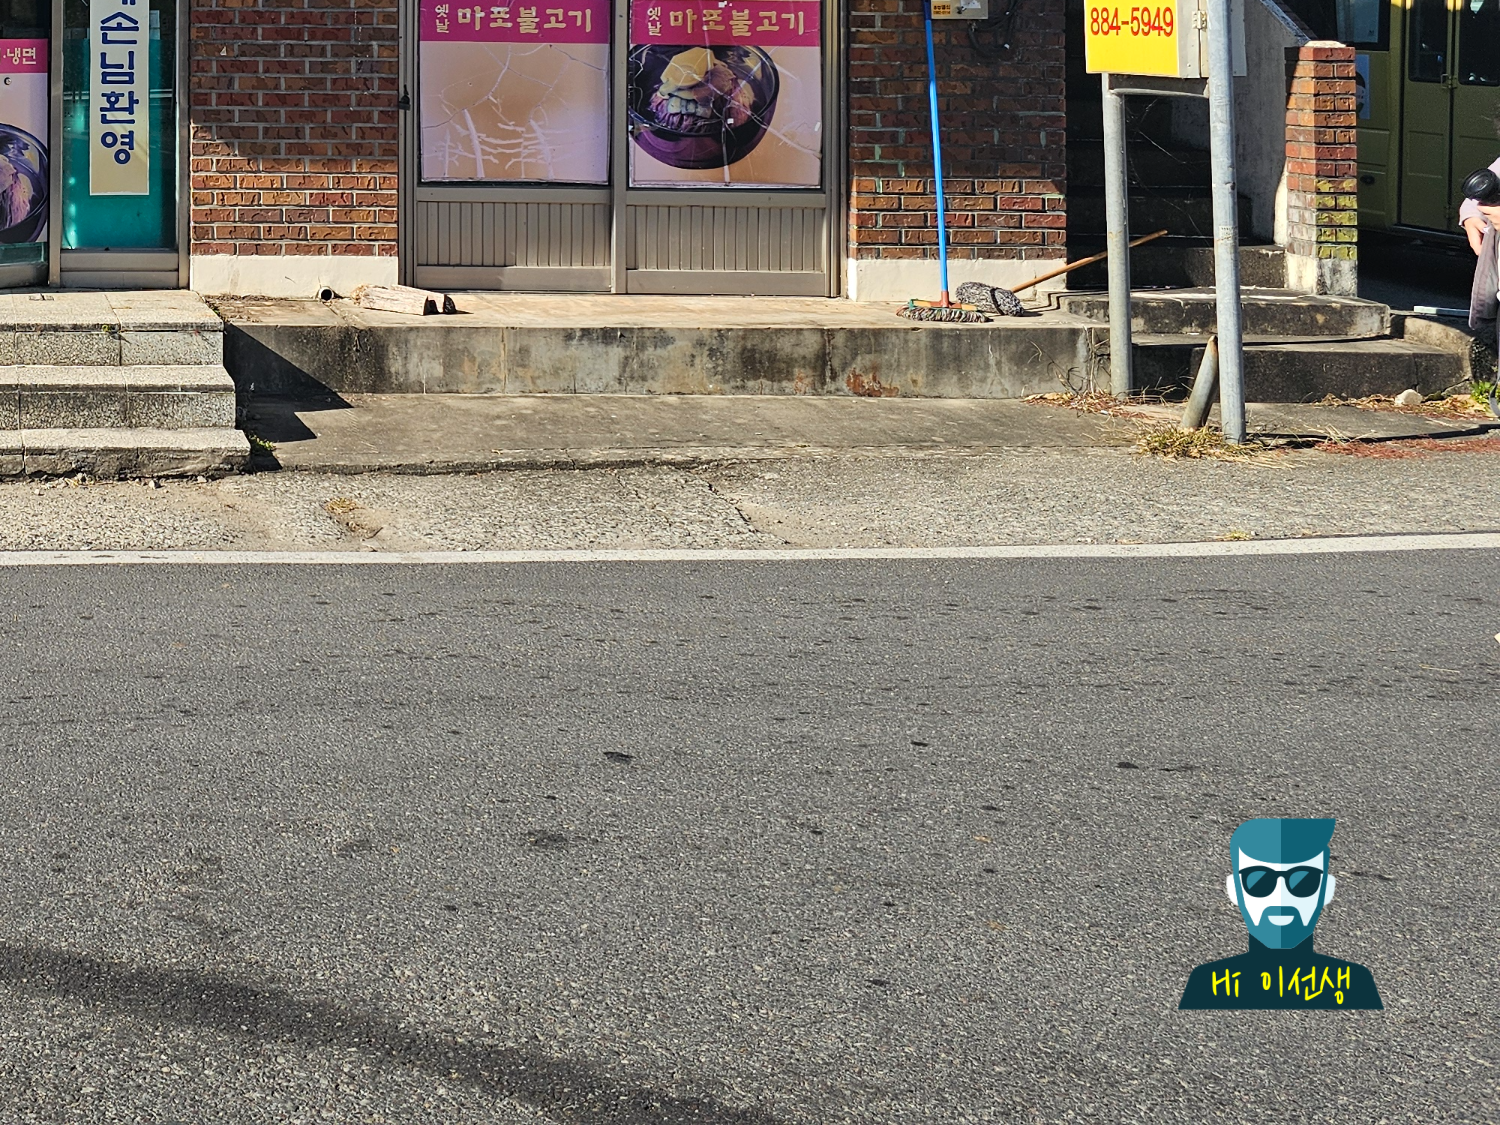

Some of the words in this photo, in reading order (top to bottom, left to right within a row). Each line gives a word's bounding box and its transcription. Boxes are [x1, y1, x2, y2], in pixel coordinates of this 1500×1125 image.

[434, 3, 450, 34] 옛날
[457, 5, 593, 34] 마포불고기
[647, 6, 662, 37] 옛날
[669, 7, 805, 37] 마포불고기
[1090, 6, 1174, 38] 884-5949
